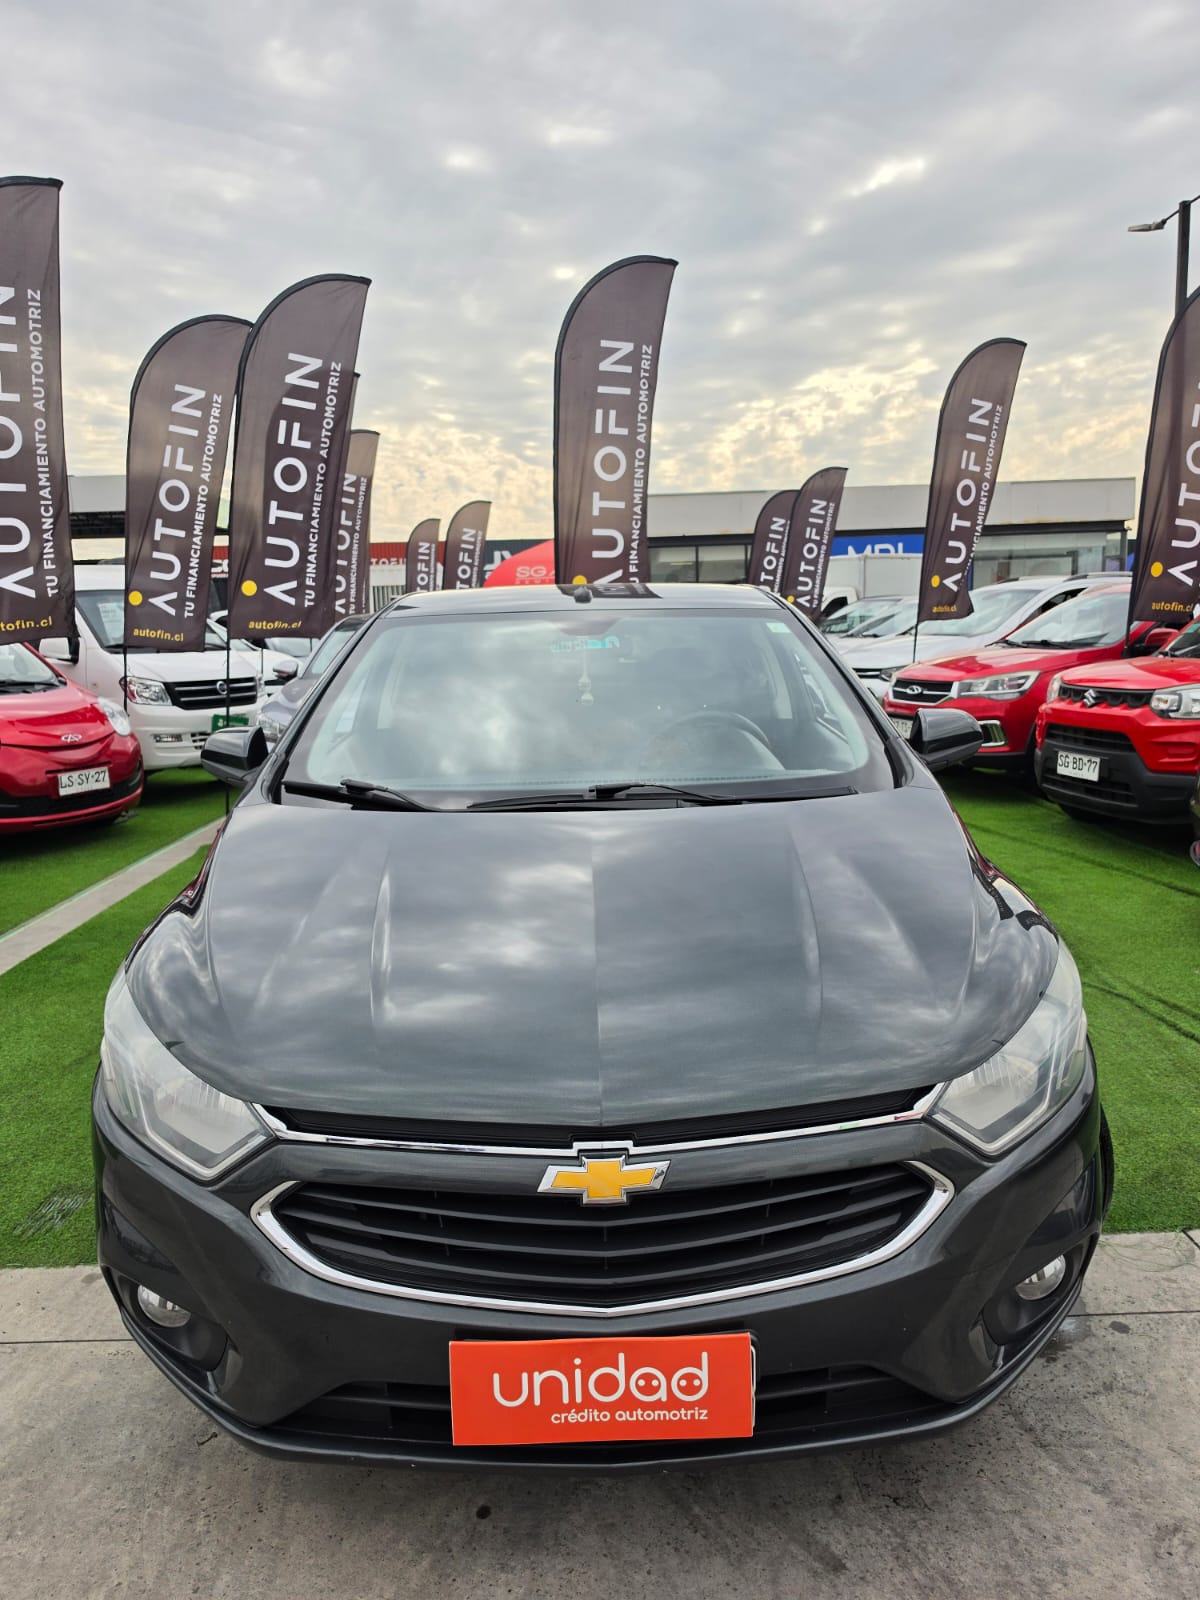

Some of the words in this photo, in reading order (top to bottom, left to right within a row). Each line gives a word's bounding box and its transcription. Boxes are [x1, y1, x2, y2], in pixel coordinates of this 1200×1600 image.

[27, 288, 46, 412] AUTOMOTRIZ
[635, 344, 653, 444] AUTOMOTRIZ
[201, 393, 223, 483] AUTOMOTRIZ
[319, 361, 342, 459] AUTOMOTRIZ
[984, 405, 1003, 479] AUTOMOTRIZ
[34, 418, 57, 570] FINANCIAMIENTO
[147, 383, 207, 617] AUTOFIN
[263, 352, 324, 607] AUTOFIN
[592, 339, 635, 584] AUTOFIN
[942, 398, 993, 593] AUTOFIN
[186, 485, 209, 600] FINANCIAMIENTO
[305, 464, 327, 586] FINANCIAMIENTO
[628, 448, 647, 572] FINANCIAMIENTO
[761, 517, 787, 583] TOFIN
[796, 499, 828, 608] AUTOFIN
[45, 575, 59, 598] TU
[304, 592, 316, 609] TU
[455, 527, 477, 590] TOFIN
[0, 615, 53, 632] tofin.cl
[133, 628, 184, 642] autofin.cl
[184, 602, 196, 619] TU
[248, 620, 303, 630] autofin.cl
[1151, 602, 1194, 613] autofin.cl
[492, 1351, 710, 1408] unidad
[550, 1407, 611, 1424] crédito
[614, 1406, 709, 1422] automotriz
